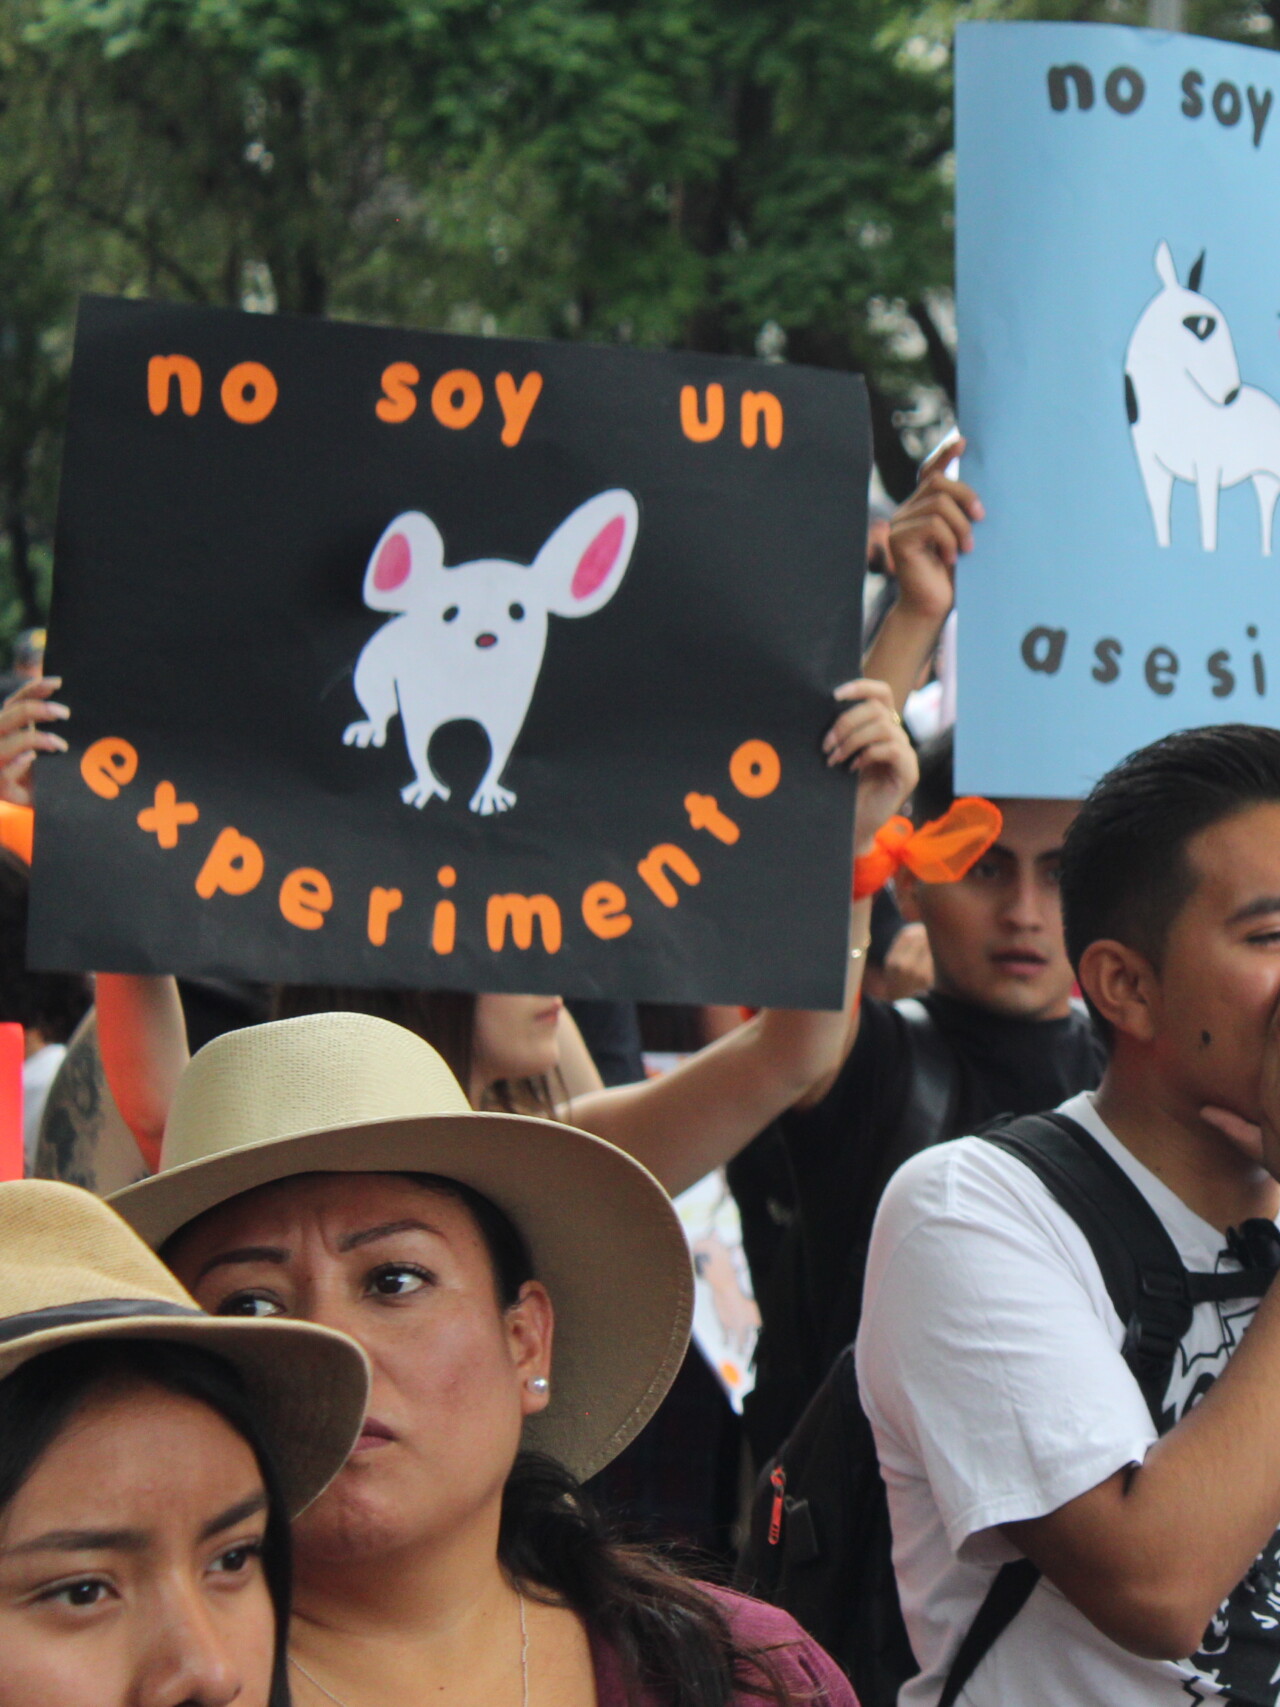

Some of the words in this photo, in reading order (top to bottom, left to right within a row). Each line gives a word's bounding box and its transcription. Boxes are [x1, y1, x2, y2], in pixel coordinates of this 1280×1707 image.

[1046, 63, 1146, 115] no
[1180, 69, 1274, 148] soy
[148, 354, 278, 424] no
[375, 362, 543, 447] soy
[680, 383, 784, 449] un
[81, 738, 781, 955] experimento
